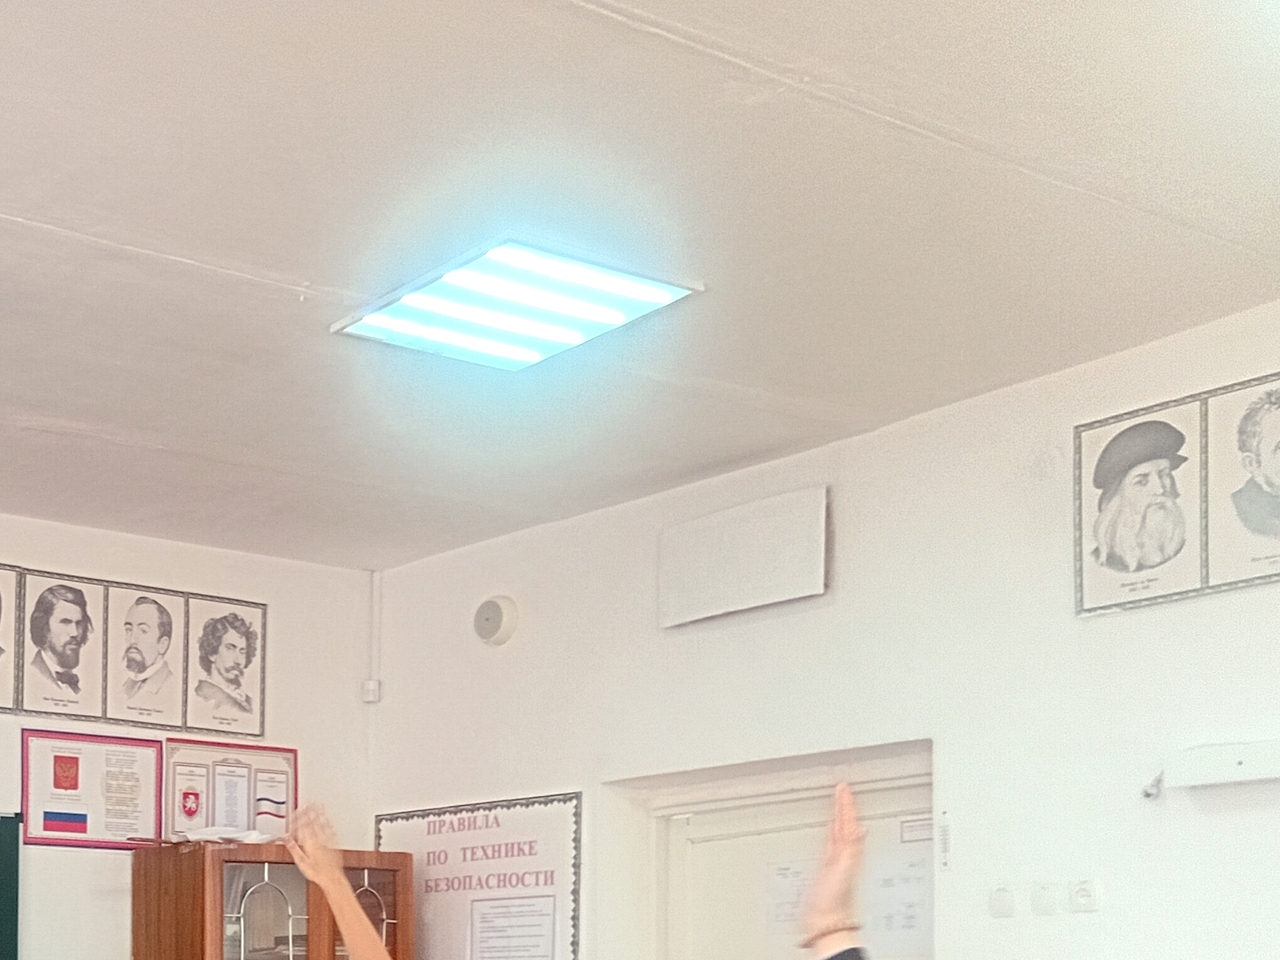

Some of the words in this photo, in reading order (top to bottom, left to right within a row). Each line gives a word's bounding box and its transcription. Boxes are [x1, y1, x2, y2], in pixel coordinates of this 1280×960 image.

[426, 813, 501, 836] ПРАВИЛА
[426, 849, 449, 867] ПО
[460, 840, 538, 863] ТЕХНИКЕ
[423, 870, 556, 894] БЕЗОПАСНОСТИ
